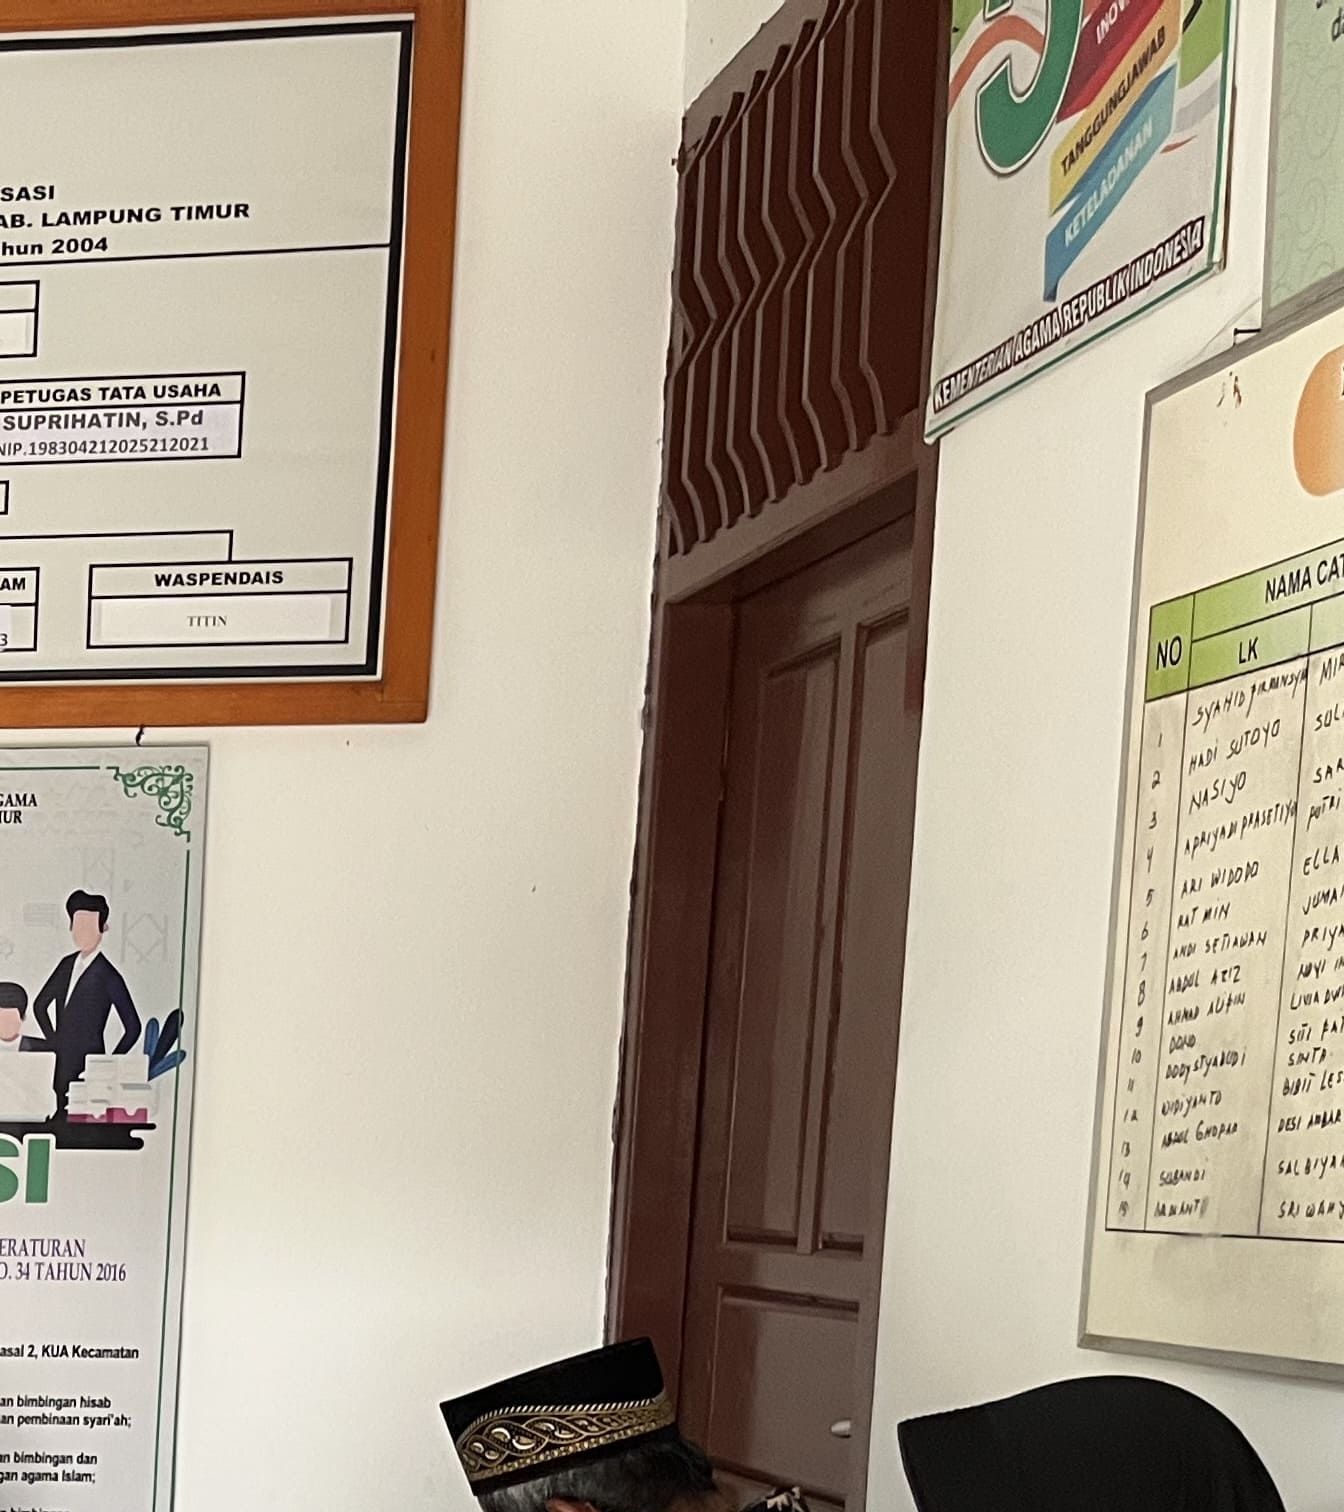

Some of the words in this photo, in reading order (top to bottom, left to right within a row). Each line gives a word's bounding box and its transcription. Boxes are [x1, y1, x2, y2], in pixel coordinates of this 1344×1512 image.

[1060, 25, 1166, 177] TANGGUNGJAWAB
[1063, 116, 1153, 247] KETELADANAN
[41, 207, 162, 228] LAMPUNG
[170, 203, 250, 221] TIMUR
[51, 237, 109, 254] 2004
[934, 336, 1014, 413] KEMENTERIAN
[1013, 306, 1062, 366] AGAMA
[1062, 265, 1129, 335] REPUBLIK
[1128, 216, 1205, 297] INDONESIA
[0, 388, 91, 404] PETUGAS
[98, 386, 146, 400] TATA
[153, 383, 221, 398] USAHA
[3, 411, 148, 431] SUPRIHATIN,
[155, 410, 204, 427] S.Pd
[154, 571, 284, 587] WASPENDAIS
[1265, 565, 1312, 603] NAMA
[187, 615, 228, 627] TITIN
[1156, 635, 1182, 671] NO
[1238, 636, 1259, 664] LK
[1226, 718, 1281, 760] SUTOYO
[1189, 771, 1247, 815] NASIYO
[1303, 844, 1340, 876] ELLA
[1211, 860, 1259, 888] WIDODO
[14, 1262, 31, 1280] 34
[34, 1262, 93, 1281] TAHUN
[96, 1263, 127, 1282] 2016
[27, 1345, 38, 1360] 2,
[42, 1345, 68, 1358] KUA
[72, 1345, 139, 1359] Kecamatan
[17, 1395, 77, 1411] bimbingan
[80, 1396, 111, 1409] hisab
[17, 1413, 80, 1428] pembinaan
[13, 1452, 73, 1467] bimbingan
[76, 1453, 97, 1465] dan
[20, 1471, 59, 1484] agama
[61, 1470, 96, 1484] Islam;
